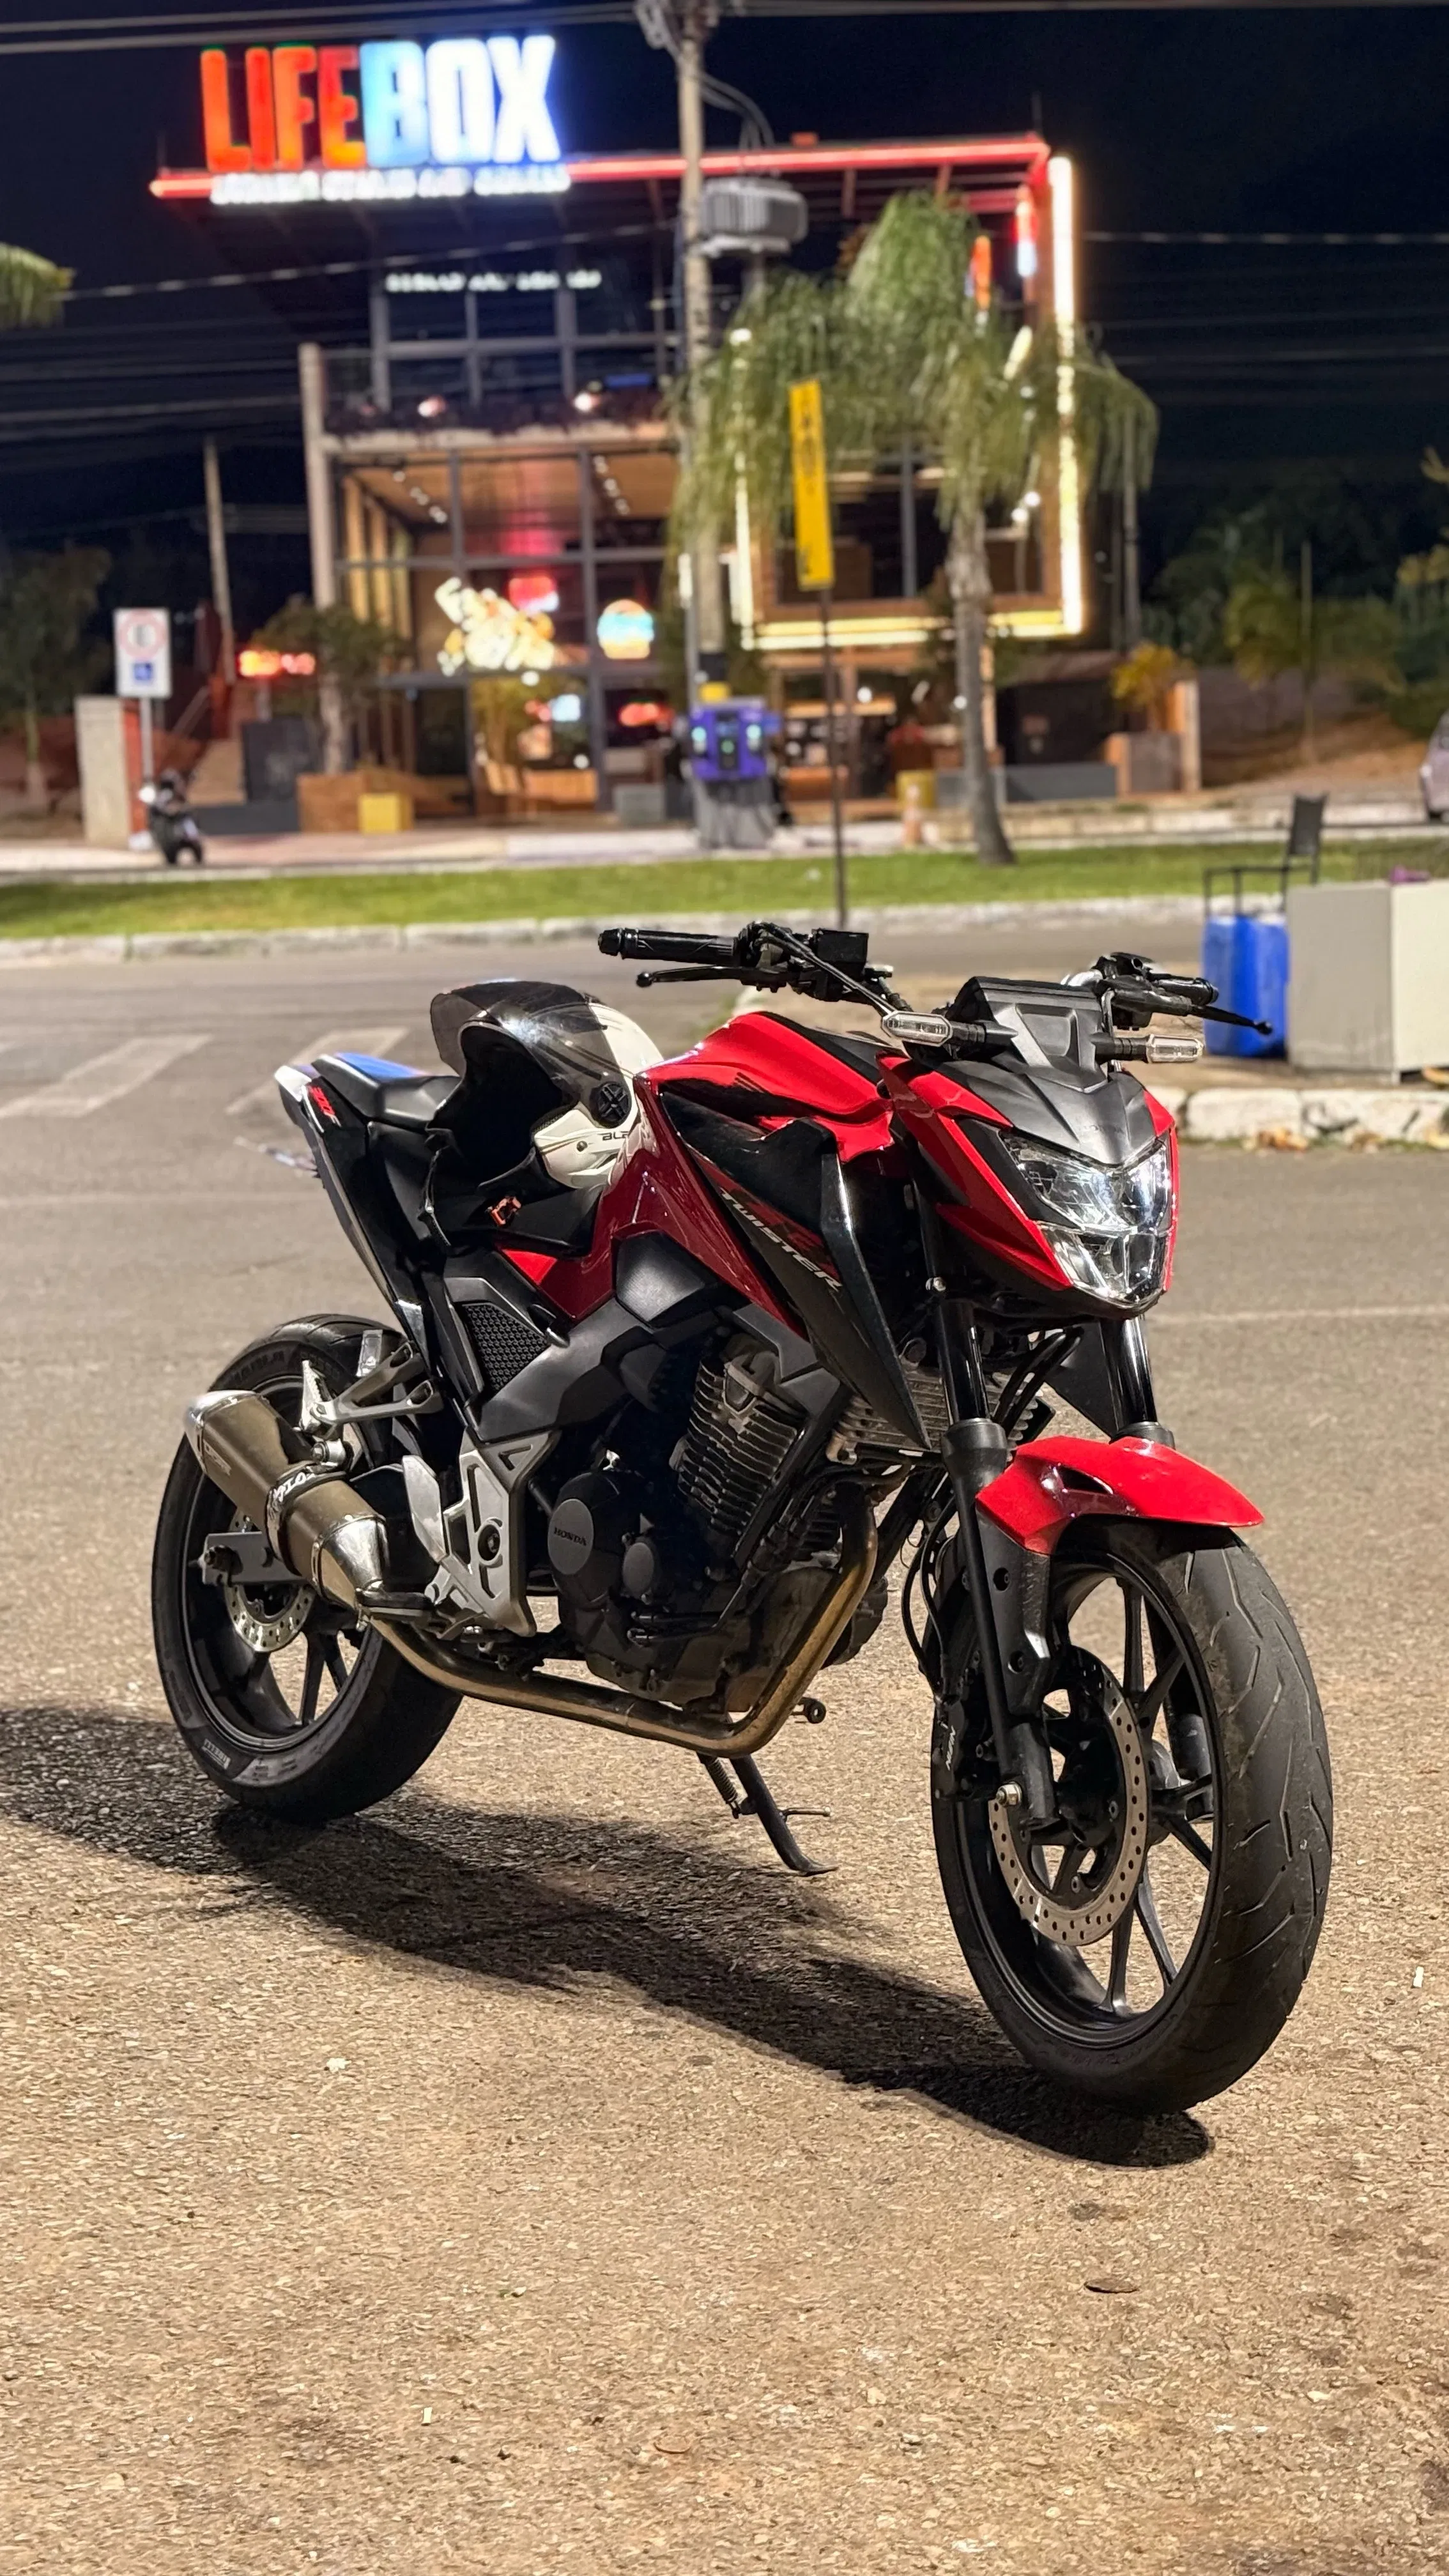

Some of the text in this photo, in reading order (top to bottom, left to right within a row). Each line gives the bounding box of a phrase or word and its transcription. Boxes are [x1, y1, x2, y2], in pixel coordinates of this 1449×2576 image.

[200, 35, 562, 172] LIFEBOX
[719, 1187, 843, 1292] TWISTER
[553, 1526, 587, 1546] HONDA
